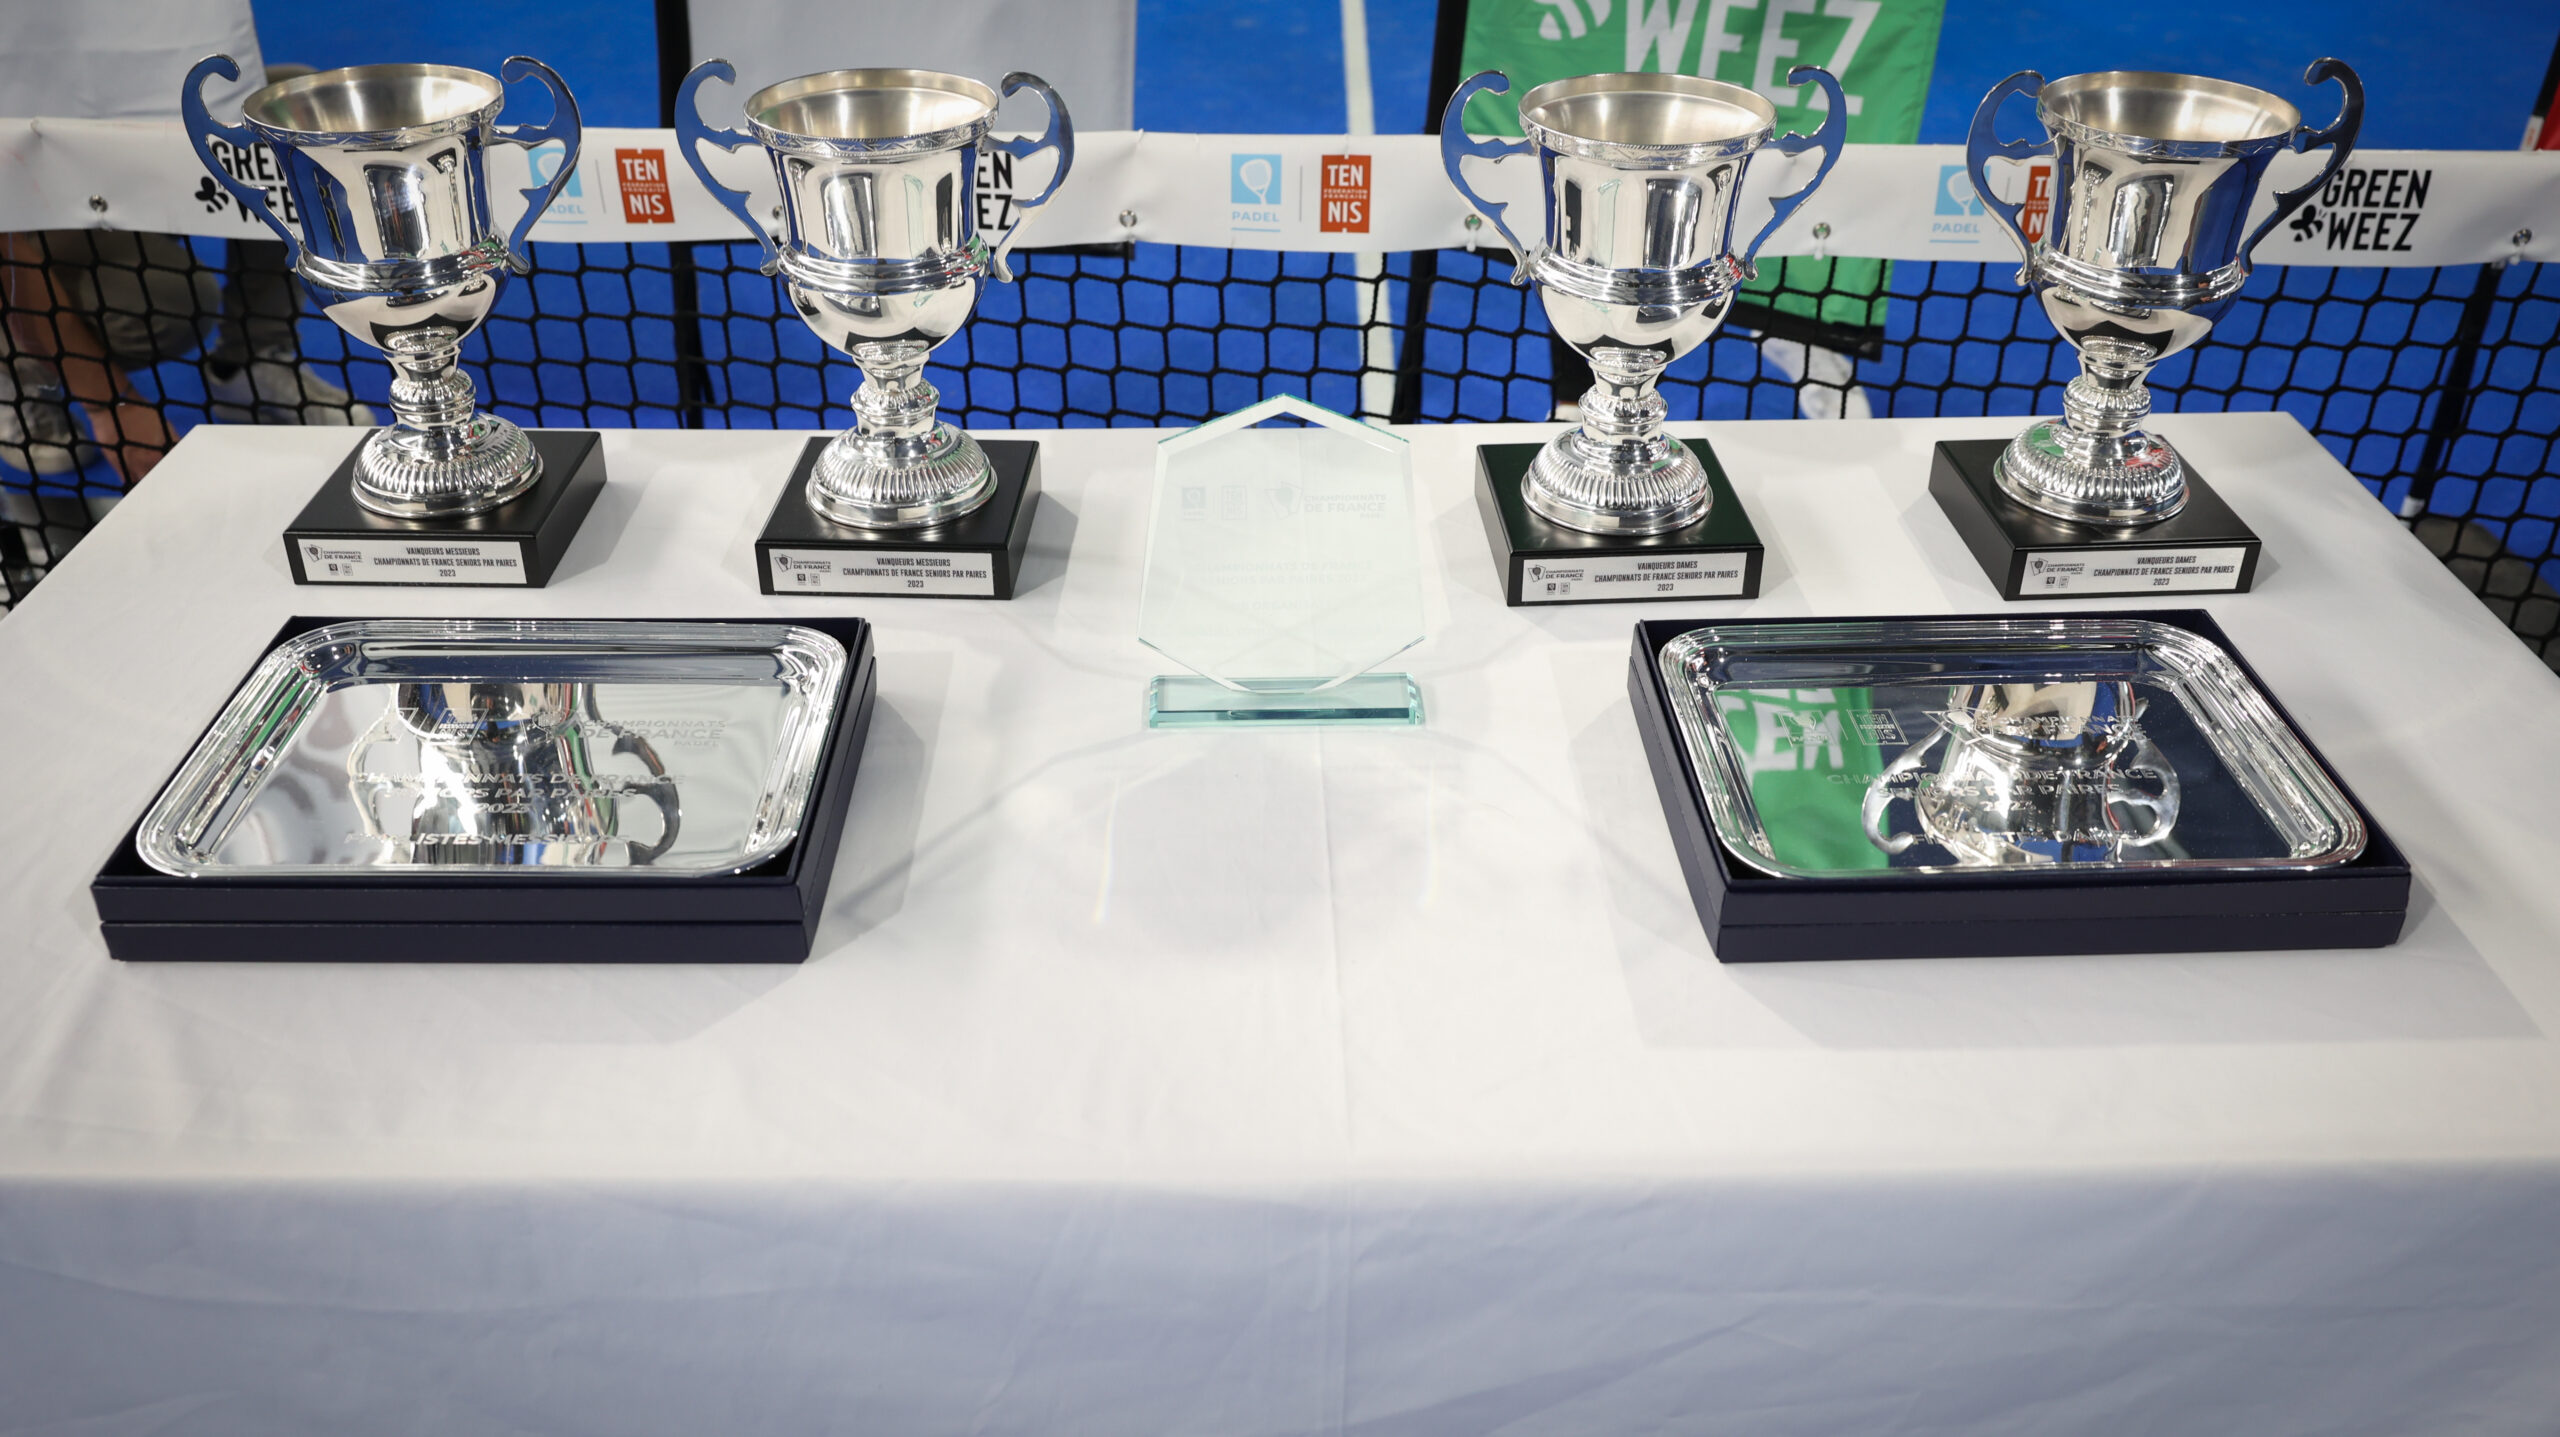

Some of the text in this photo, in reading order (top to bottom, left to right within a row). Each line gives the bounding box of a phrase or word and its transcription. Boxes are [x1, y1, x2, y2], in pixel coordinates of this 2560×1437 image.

[622, 158, 660, 181] TEN
[1327, 164, 1364, 187] TEN
[2321, 169, 2433, 209] GREEN
[546, 204, 585, 215] ADEL
[629, 194, 666, 215] NIS
[1232, 211, 1280, 223] PADEL
[1328, 201, 1363, 224] NIS
[1932, 222, 1980, 233] PADEL
[2327, 212, 2421, 251] WEEZ
[1304, 502, 1386, 513] DE FRANCE
[406, 547, 481, 556] VAINQUEURS MESSIEURS
[374, 557, 518, 568] CHAMPIONNATS DE FRANCE SENIORS PAR PAIRES
[876, 557, 951, 567] VAINQUEURS MESSIEURS
[1637, 560, 1699, 571] VAINQUEURS DAMES
[2136, 555, 2197, 565] VAINQUEURS DAMES
[439, 569, 456, 577] 2023
[842, 567, 890, 577] CHAMPIONNATS
[891, 568, 899, 577] DE
[900, 568, 925, 578] FRANCE
[925, 569, 951, 578] SENIORS
[952, 570, 964, 579] PAR
[965, 570, 988, 579] PAIRES
[1594, 569, 1739, 583] CHAMPIONNATS DE FRANCE SENIORS PAR PAIRES
[2093, 567, 2140, 577] CHAMPIONNATS
[2140, 567, 2149, 576] DE
[2149, 566, 2173, 576] FRANCE
[2173, 566, 2200, 575] SENIORS
[2200, 565, 2213, 575] PAR
[2213, 565, 2236, 574] PAIRES
[907, 580, 924, 588] 2023
[2152, 577, 2171, 586] 2023
[1657, 583, 1674, 592] 2023
